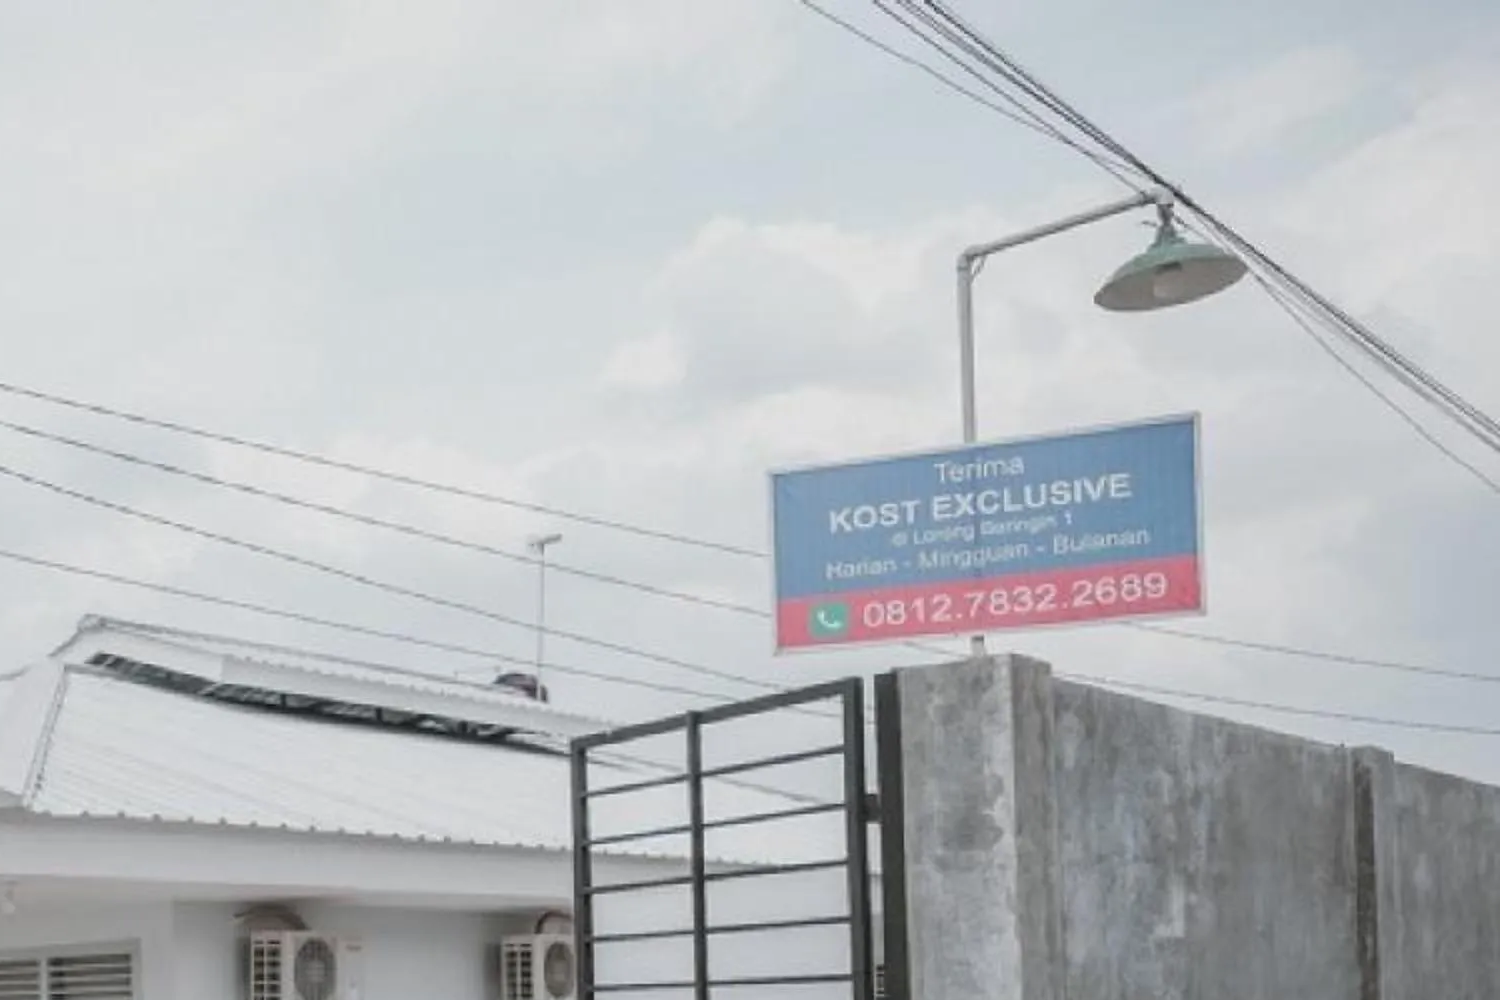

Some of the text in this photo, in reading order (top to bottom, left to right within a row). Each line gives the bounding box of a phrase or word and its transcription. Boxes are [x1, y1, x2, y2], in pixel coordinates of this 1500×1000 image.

[934, 453, 1024, 484] Terima
[829, 473, 1132, 535] KOST EXCLUSIVE
[825, 556, 898, 580] Harian
[918, 542, 1028, 570] Mingguan
[1053, 528, 1150, 555] Bulanan
[863, 571, 1168, 628] 0812.7832.2689
